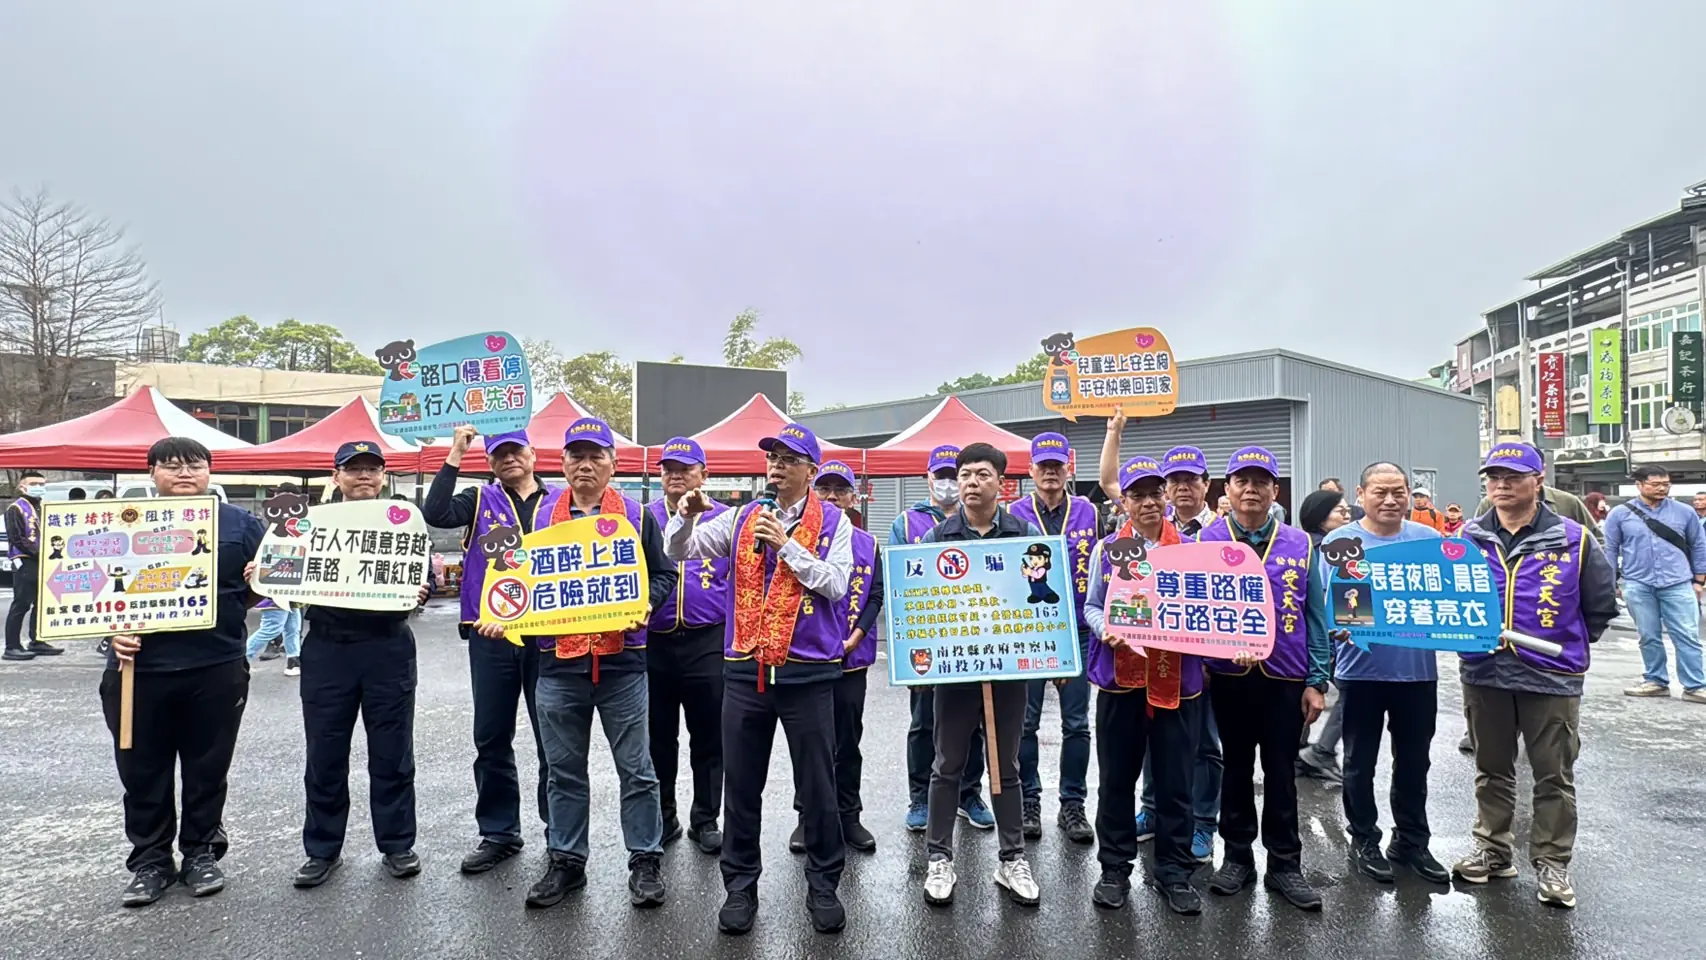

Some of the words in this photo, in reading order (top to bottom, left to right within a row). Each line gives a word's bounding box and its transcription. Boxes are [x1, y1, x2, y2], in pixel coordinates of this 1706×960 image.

[421, 354, 523, 388] 路口慢看停
[1078, 352, 1169, 374] 兒童坐上安全椅
[424, 383, 527, 417] 行人優先行
[1080, 375, 1172, 397] 平安快樂回到家
[145, 509, 175, 522] 阻詐
[310, 527, 428, 557] 行人不隨意穿越
[530, 538, 638, 577] 酒醉上道
[1075, 539, 1089, 594] 受天宮
[1371, 562, 1491, 593] 長者夜間、晨昏
[532, 572, 640, 612] 危險就到
[1156, 570, 1265, 603] 尊重路權
[1281, 569, 1299, 633] 受天宮
[1537, 565, 1562, 628] 受天宮
[1157, 602, 1267, 636] 行路安全
[1383, 597, 1489, 627] 穿著亮衣
[937, 640, 1057, 658] 南投縣政府警察局
